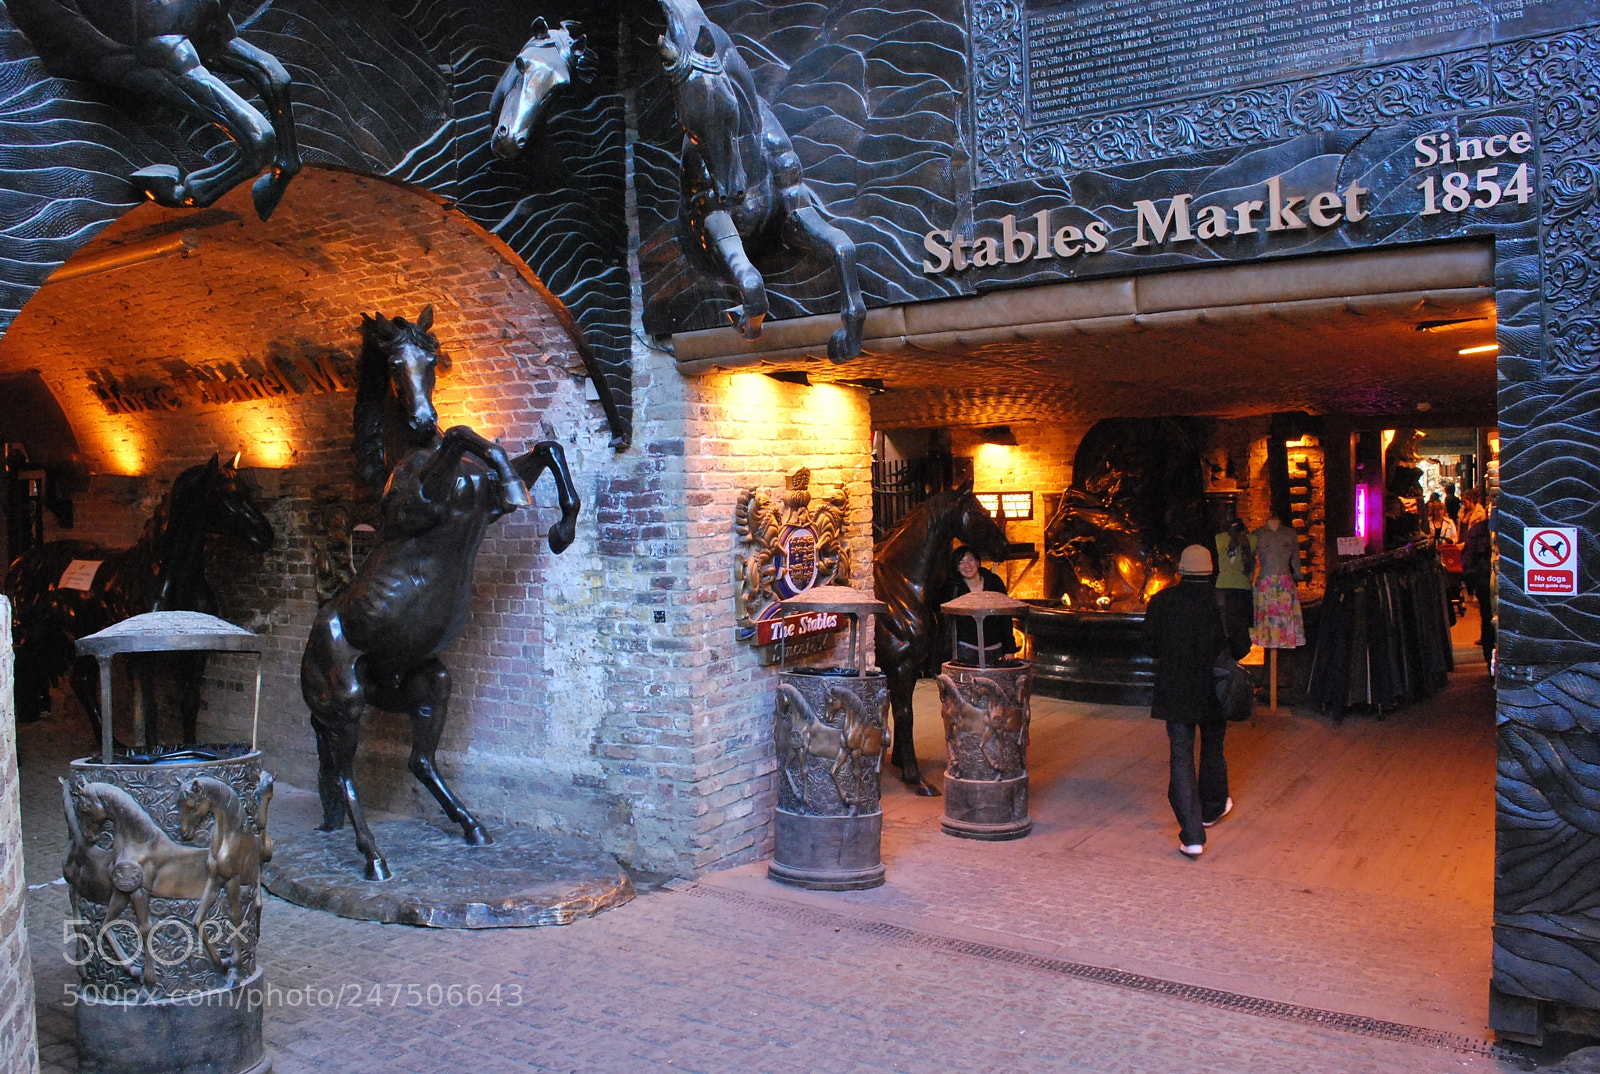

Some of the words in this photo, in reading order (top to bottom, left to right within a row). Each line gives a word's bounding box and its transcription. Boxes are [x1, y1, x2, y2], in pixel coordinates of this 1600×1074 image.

[1030, 37, 1044, 48] that
[1086, 25, 1100, 35] half
[1170, 7, 1190, 17] more
[1046, 10, 1074, 23] Stables
[1076, 2, 1103, 16] Market
[1047, 55, 1062, 65] Site
[1091, 43, 1120, 56] Stables
[1122, 35, 1151, 49] Market
[1153, 29, 1188, 43] Camden
[1216, 14, 1262, 30] fascinating
[1265, 7, 1298, 20] history.
[1032, 78, 1049, 90] 19th
[1050, 74, 1079, 86] century
[1118, 61, 1148, 73] system
[1167, 52, 1188, 63] been
[1191, 41, 1236, 58] completed
[1264, 30, 1300, 44] became
[1311, 20, 1351, 35] stopping
[1410, 0, 1452, 15] Camden
[1055, 38, 1090, 53] industrial
[1091, 34, 1110, 46] brick
[1112, 28, 1148, 41] buildings
[1150, 23, 1170, 33] were
[1065, 60, 1094, 72] houses
[1137, 40, 1184, 58] surrounded
[1199, 34, 1221, 45] fields
[1304, 12, 1327, 24] main
[1329, 6, 1350, 19] road
[1087, 78, 1111, 92] goods
[1113, 75, 1133, 85] were
[1230, 50, 1254, 63] canal
[1391, 20, 1416, 34] grew
[1493, 0, 1522, 12] along
[1032, 97, 1068, 110] However,
[1096, 86, 1124, 98] century
[1374, 28, 1432, 45] Birmingham
[1078, 99, 1108, 112] needed
[1190, 80, 1220, 91] trading
[1242, 70, 1262, 82] with
[1414, 130, 1533, 168] Since
[1417, 163, 1534, 216] 1854
[922, 211, 1109, 275] Stables
[1132, 176, 1370, 248] Market
[1534, 574, 1545, 582] No
[1546, 574, 1567, 584] dogs
[770, 621, 796, 641] The
[798, 612, 838, 635] Stables
